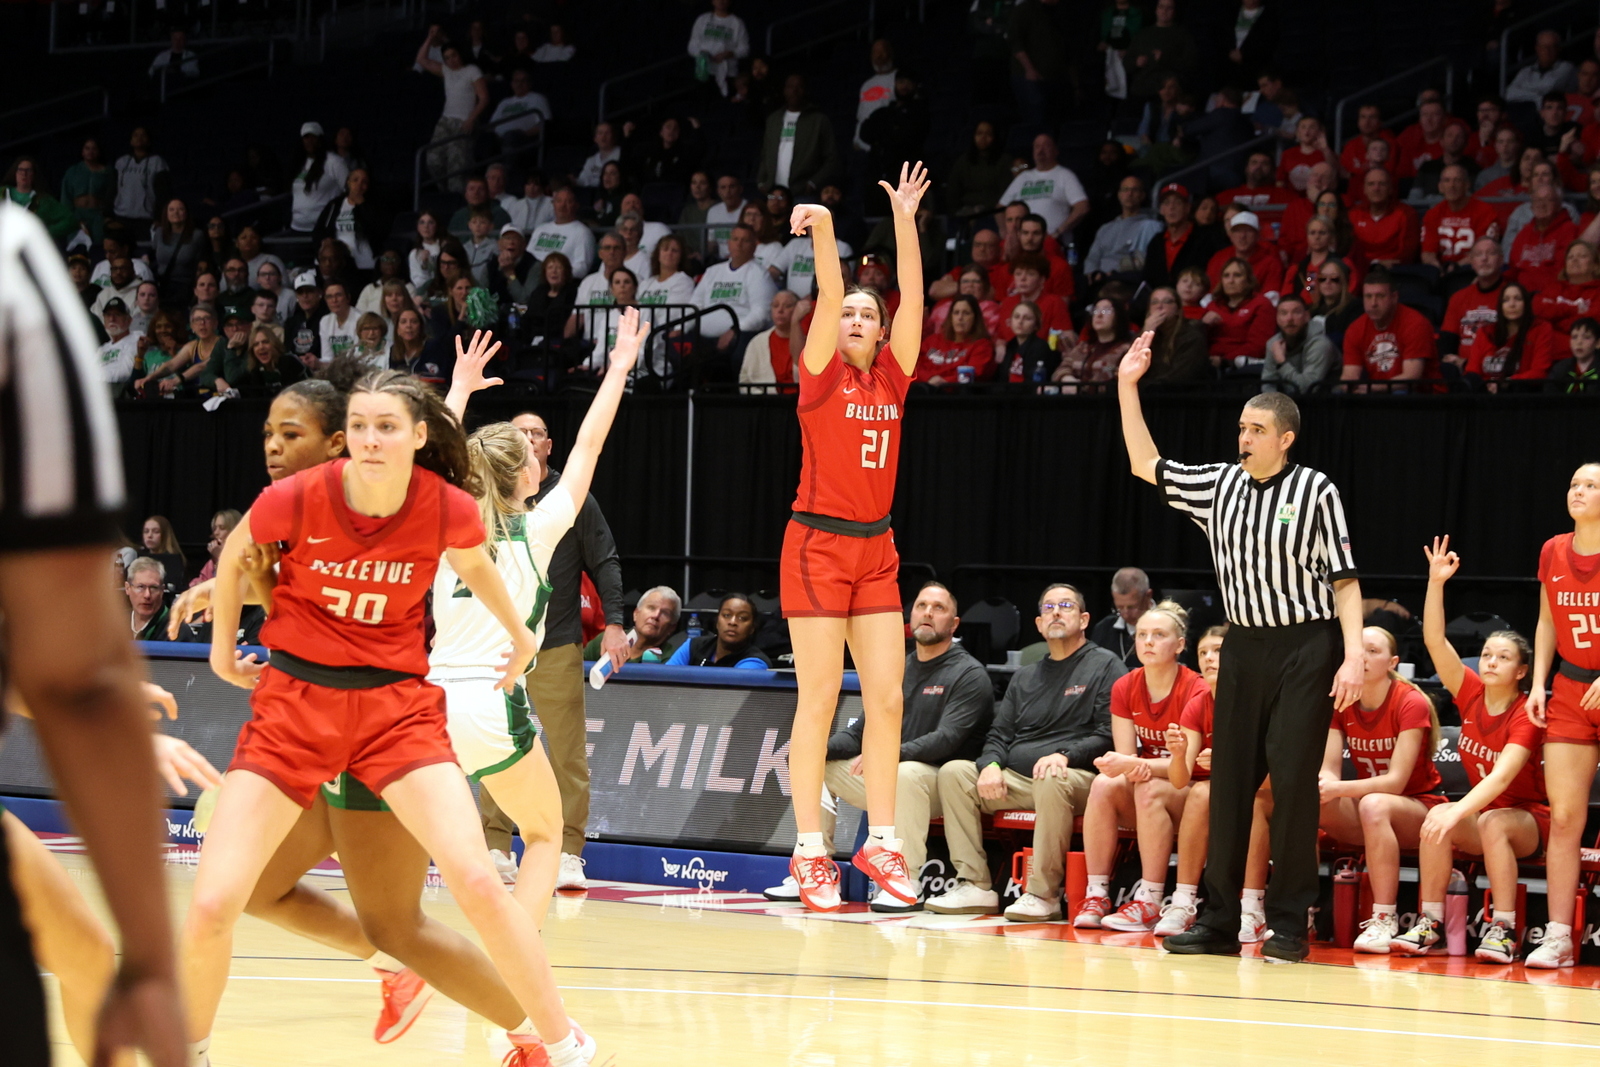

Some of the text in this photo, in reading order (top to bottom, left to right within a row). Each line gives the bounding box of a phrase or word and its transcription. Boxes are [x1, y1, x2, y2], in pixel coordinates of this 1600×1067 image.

[845, 402, 899, 421] BELLEVU
[861, 429, 890, 469] 21
[320, 585, 388, 625] 30
[1557, 591, 1600, 607] BELLEV
[618, 720, 792, 796] MILK
[1347, 735, 1397, 752] BELLEVU
[681, 857, 729, 890] Kroger
